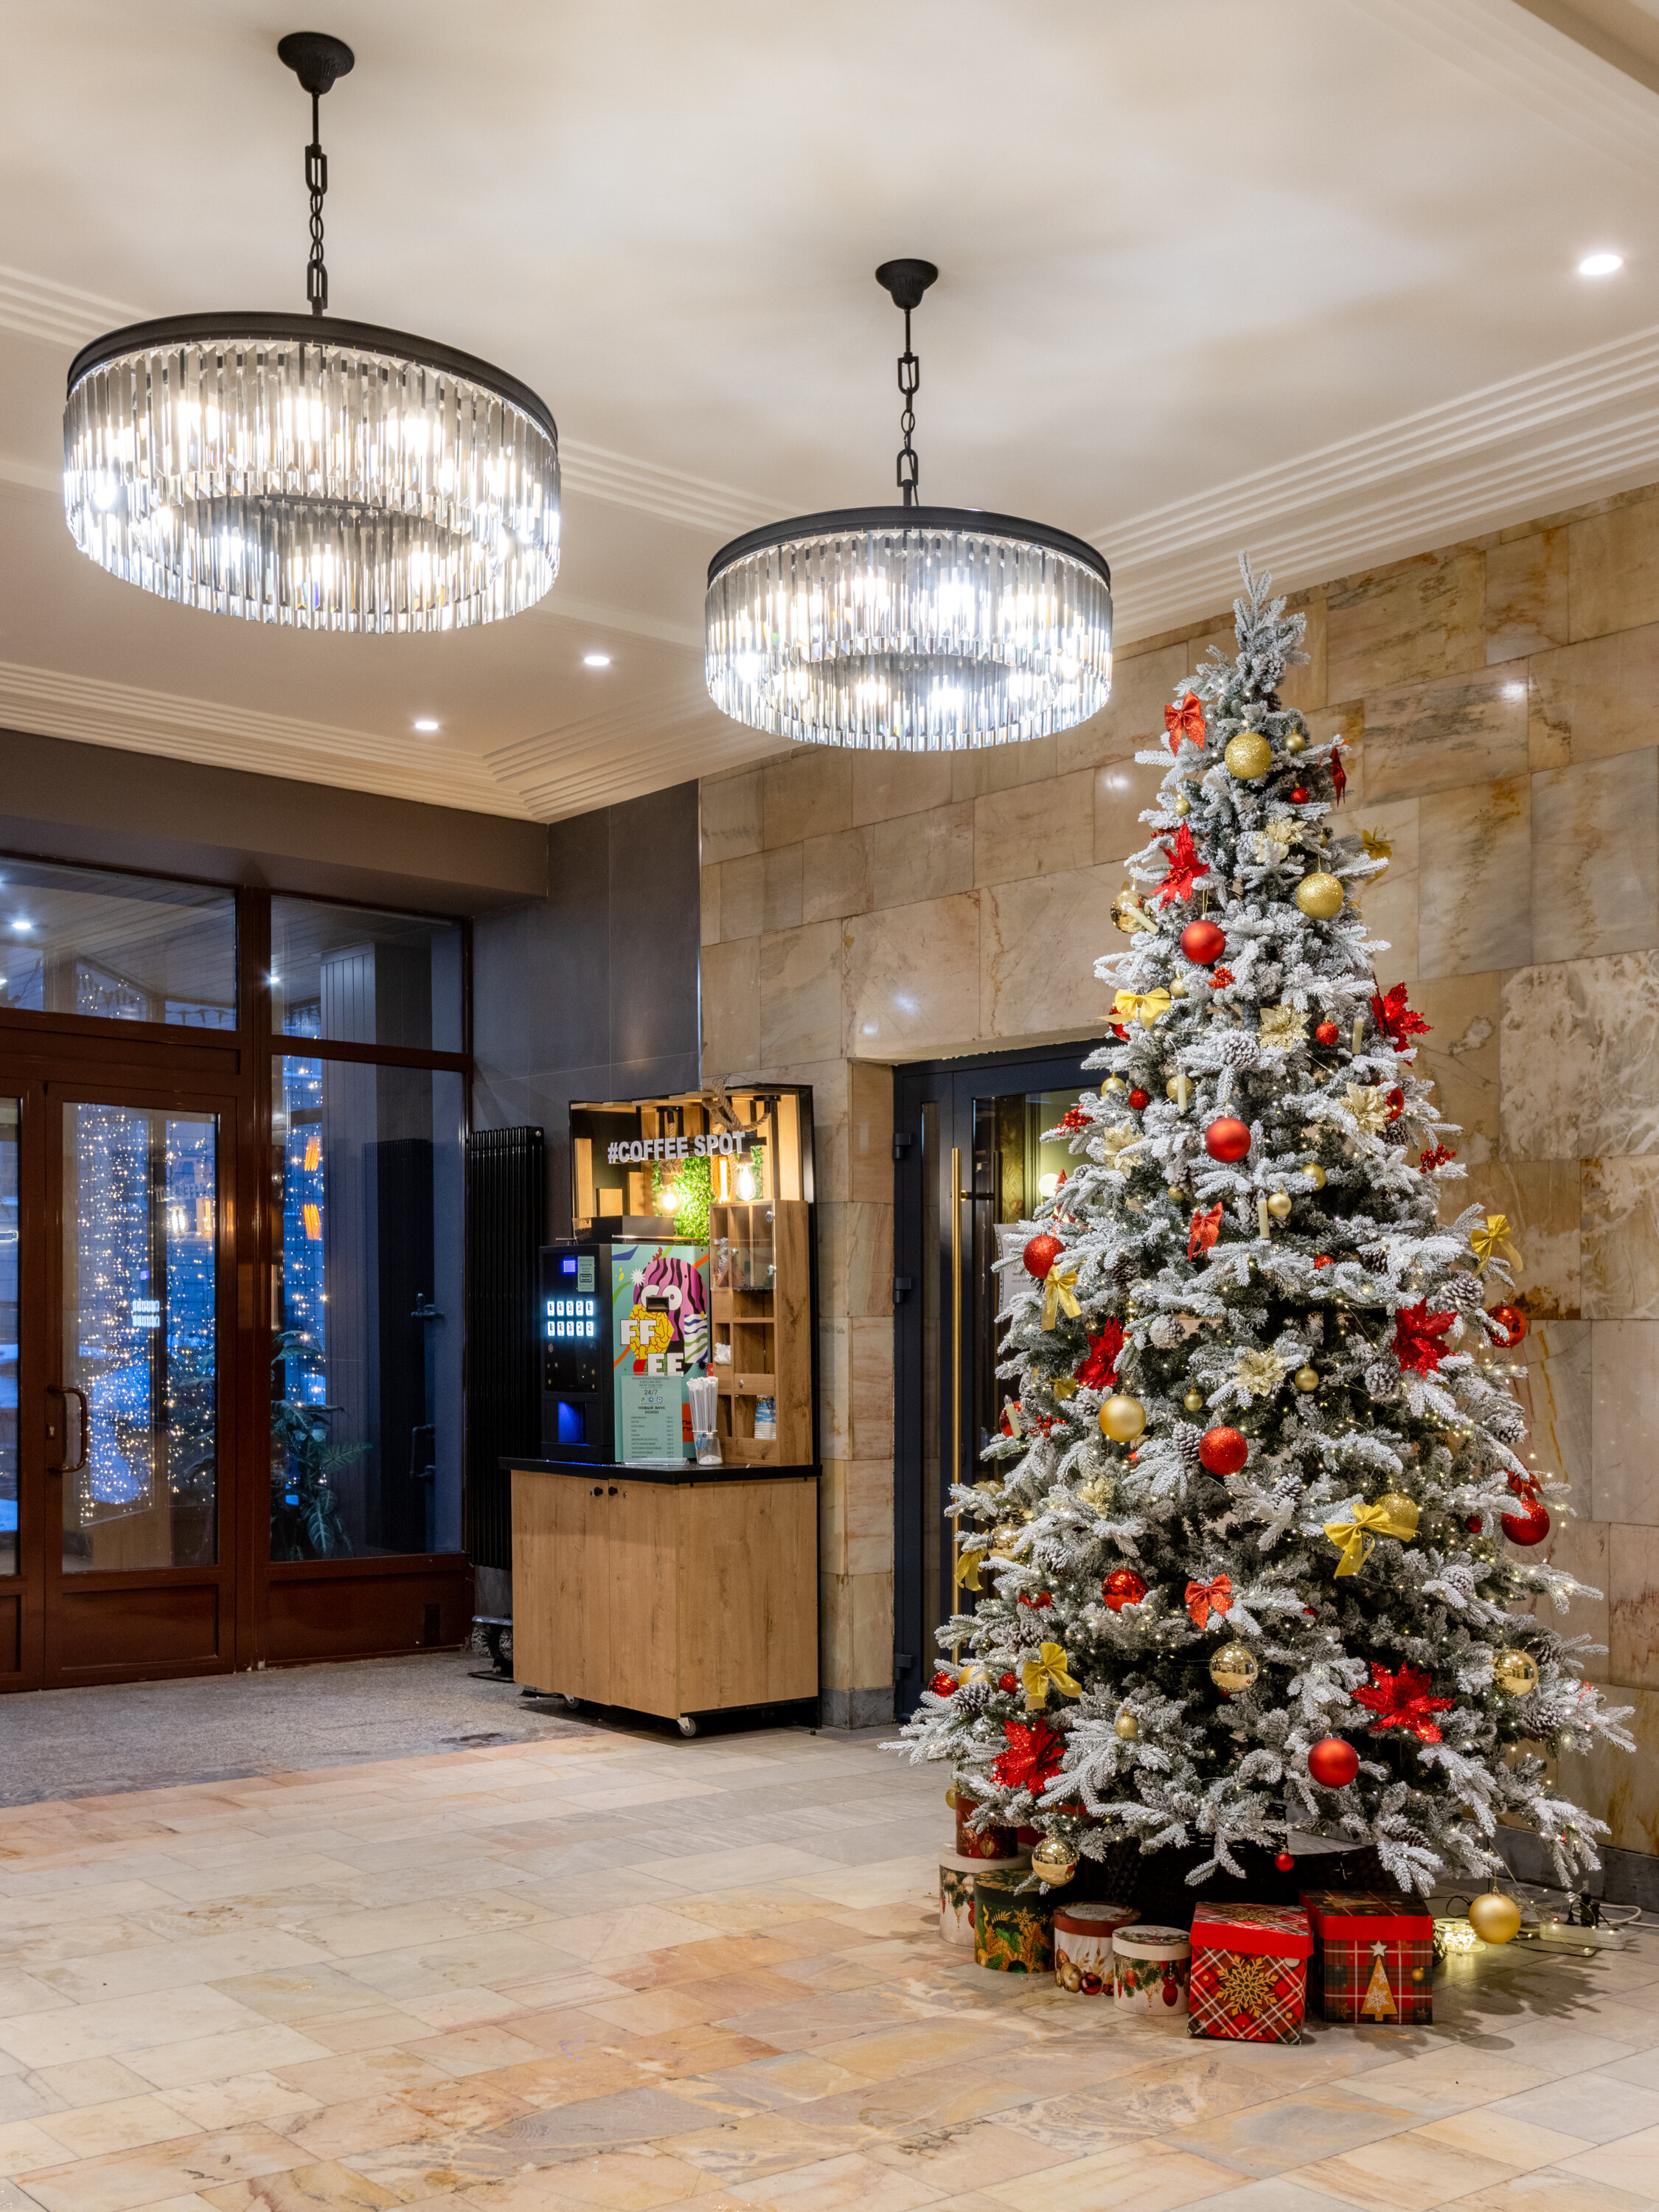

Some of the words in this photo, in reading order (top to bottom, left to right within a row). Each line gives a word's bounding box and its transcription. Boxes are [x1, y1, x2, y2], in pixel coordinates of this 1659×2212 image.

[608, 1136, 689, 1164] #COFFEE
[694, 1131, 745, 1157] SPOT
[620, 1319, 657, 1345] FF
[647, 1352, 684, 1378] EE
